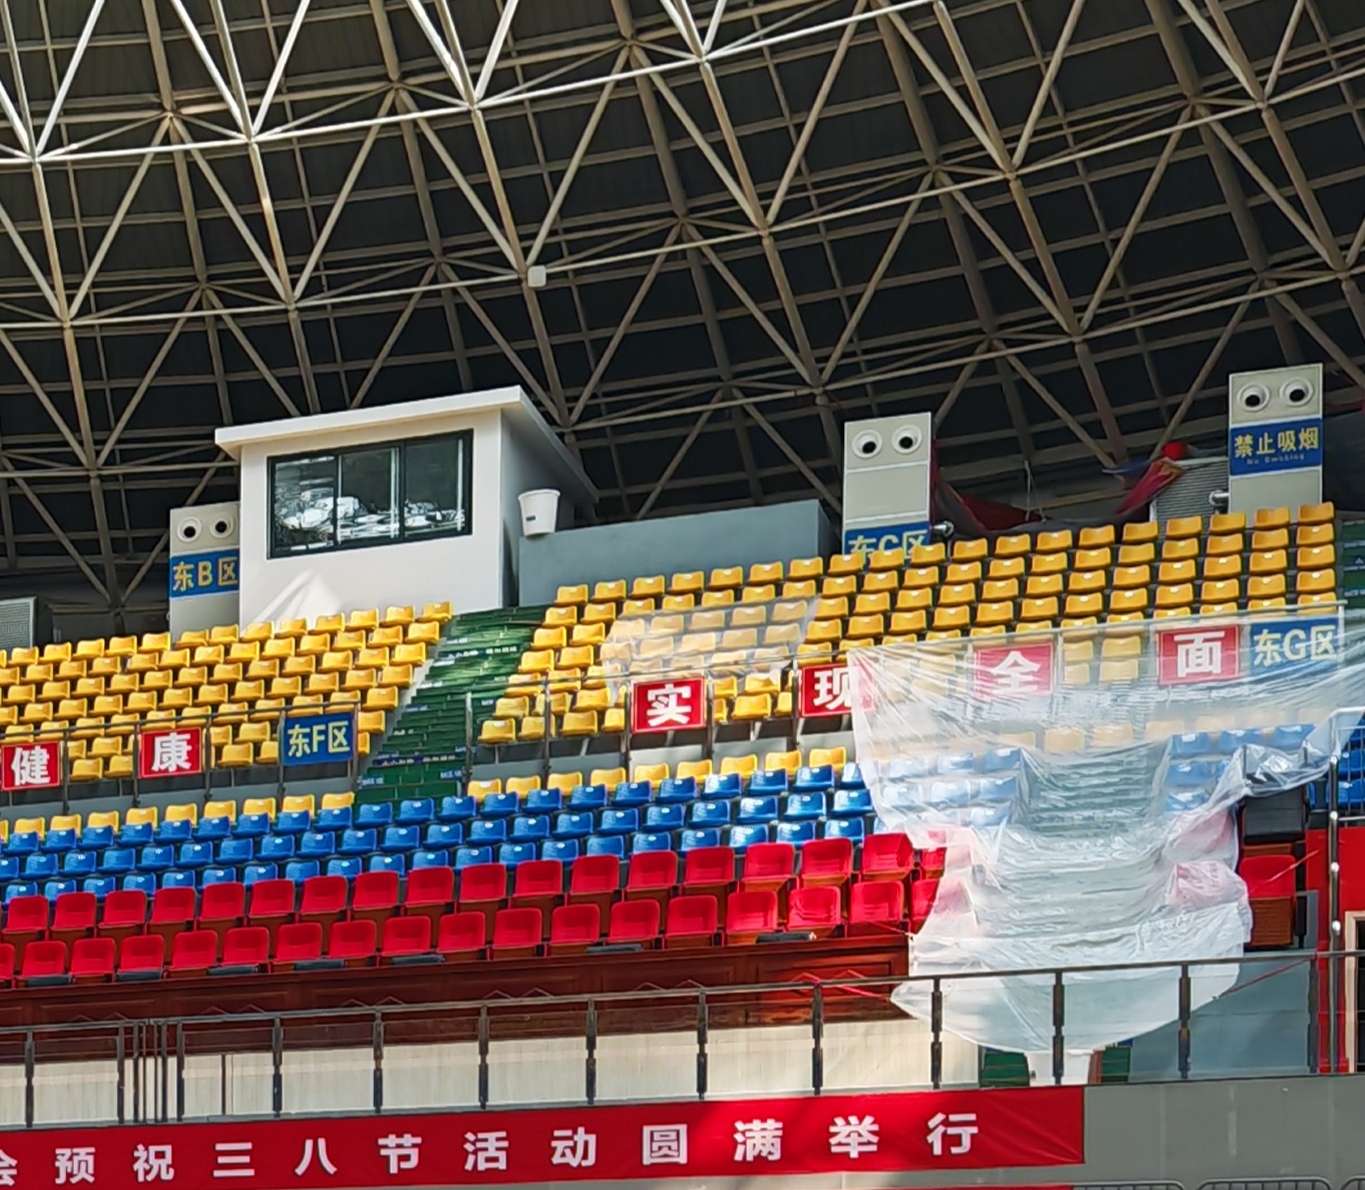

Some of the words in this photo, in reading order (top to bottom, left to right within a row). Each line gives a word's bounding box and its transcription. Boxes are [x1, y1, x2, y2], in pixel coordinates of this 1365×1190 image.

[1234, 427, 1319, 459] 禁止吸烟
[172, 555, 238, 593] 东B区
[1252, 626, 1338, 668] 东G区
[645, 682, 694, 726] 实
[992, 650, 1042, 695] 全
[1177, 631, 1222, 676] 面
[9, 745, 51, 787] 健
[150, 732, 193, 773] 康
[286, 719, 349, 759] 东F区
